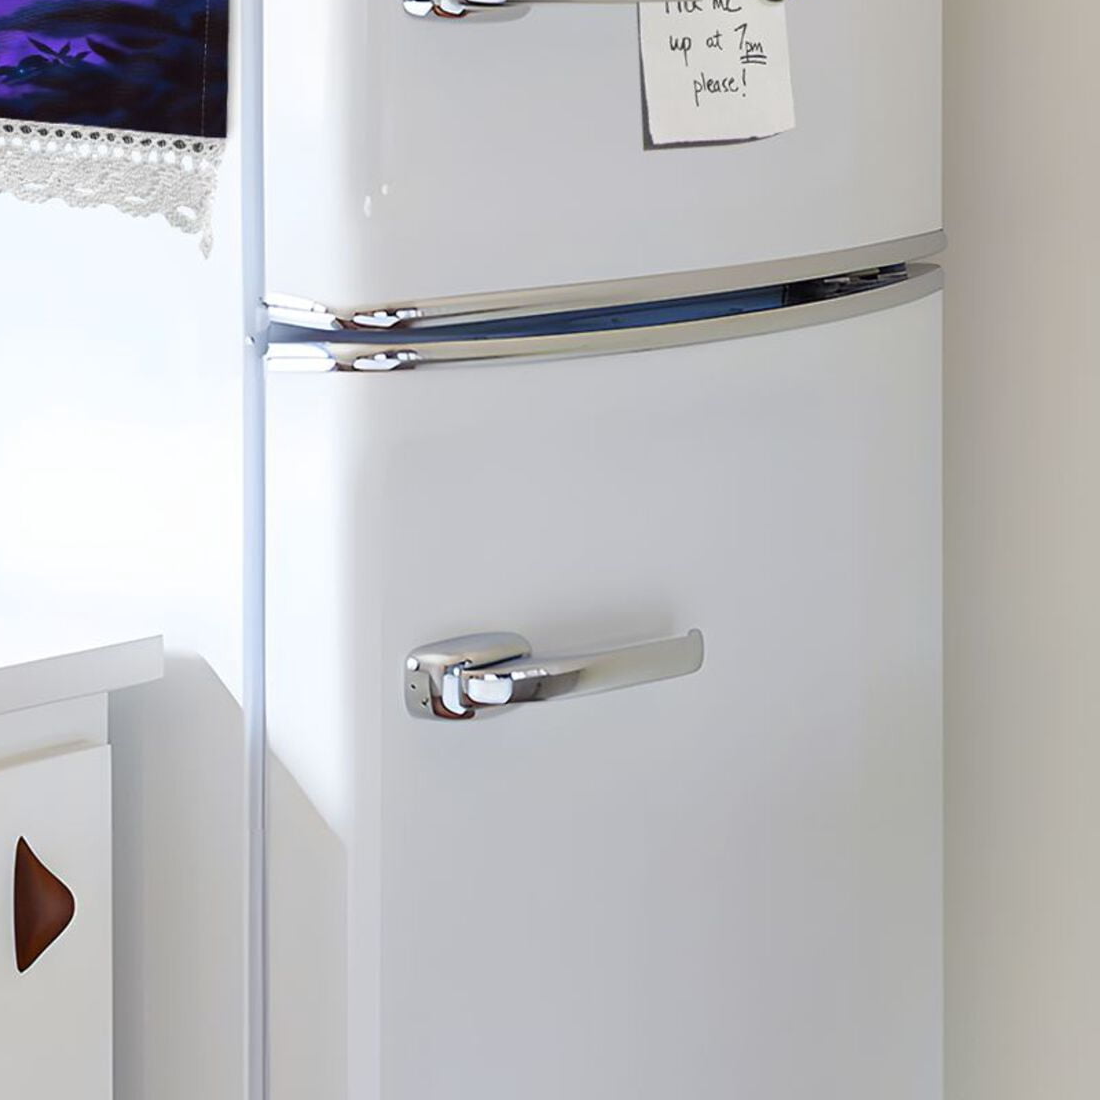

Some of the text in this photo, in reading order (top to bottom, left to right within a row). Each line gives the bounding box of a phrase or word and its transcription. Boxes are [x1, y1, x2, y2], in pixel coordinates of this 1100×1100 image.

[669, 35, 692, 66] up
[706, 29, 723, 51] at
[693, 68, 747, 107] please!
